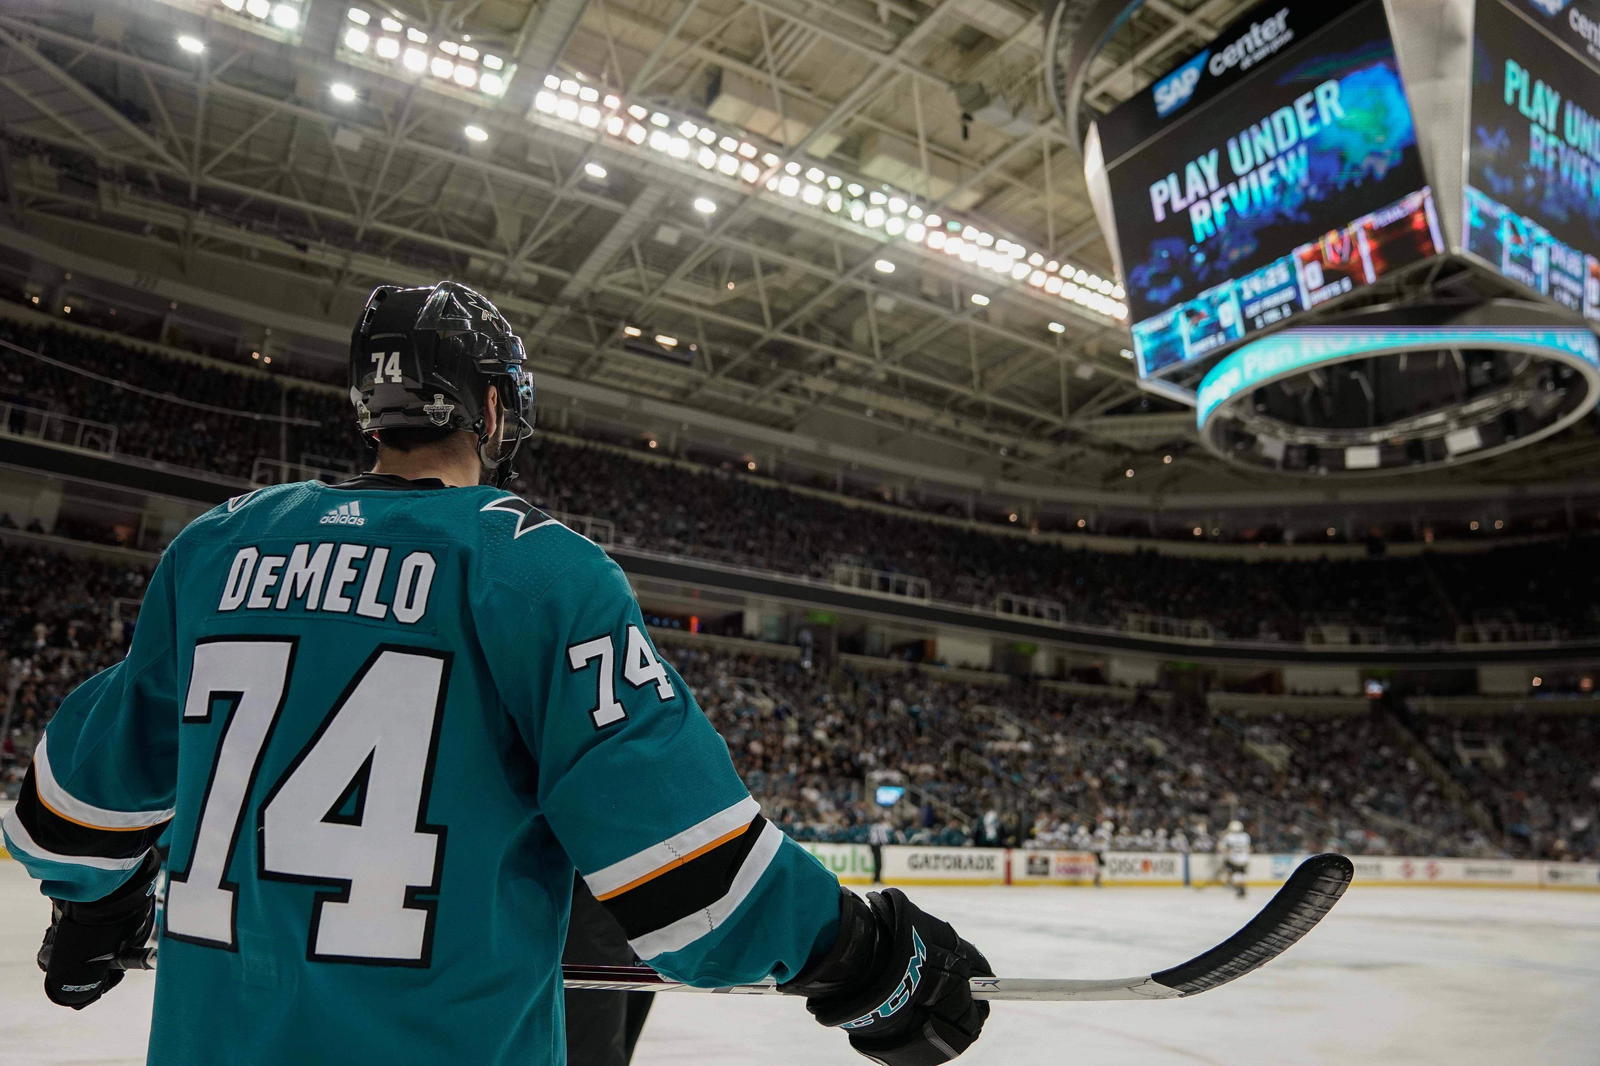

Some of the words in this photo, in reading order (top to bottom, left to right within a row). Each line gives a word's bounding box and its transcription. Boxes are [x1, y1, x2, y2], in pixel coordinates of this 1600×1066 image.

[1153, 65, 1200, 114] SAP
[1208, 6, 1290, 77] center
[1503, 57, 1561, 132] PLAY
[1149, 148, 1219, 223] PLAY
[1227, 79, 1346, 177] UNDER
[1189, 145, 1309, 244] REVIEW
[371, 352, 402, 384] 74
[319, 513, 365, 526] adidas
[568, 624, 676, 730] 74
[164, 636, 450, 966] 74
[908, 853, 996, 872] GATORADE
[838, 925, 927, 1029] CCM
